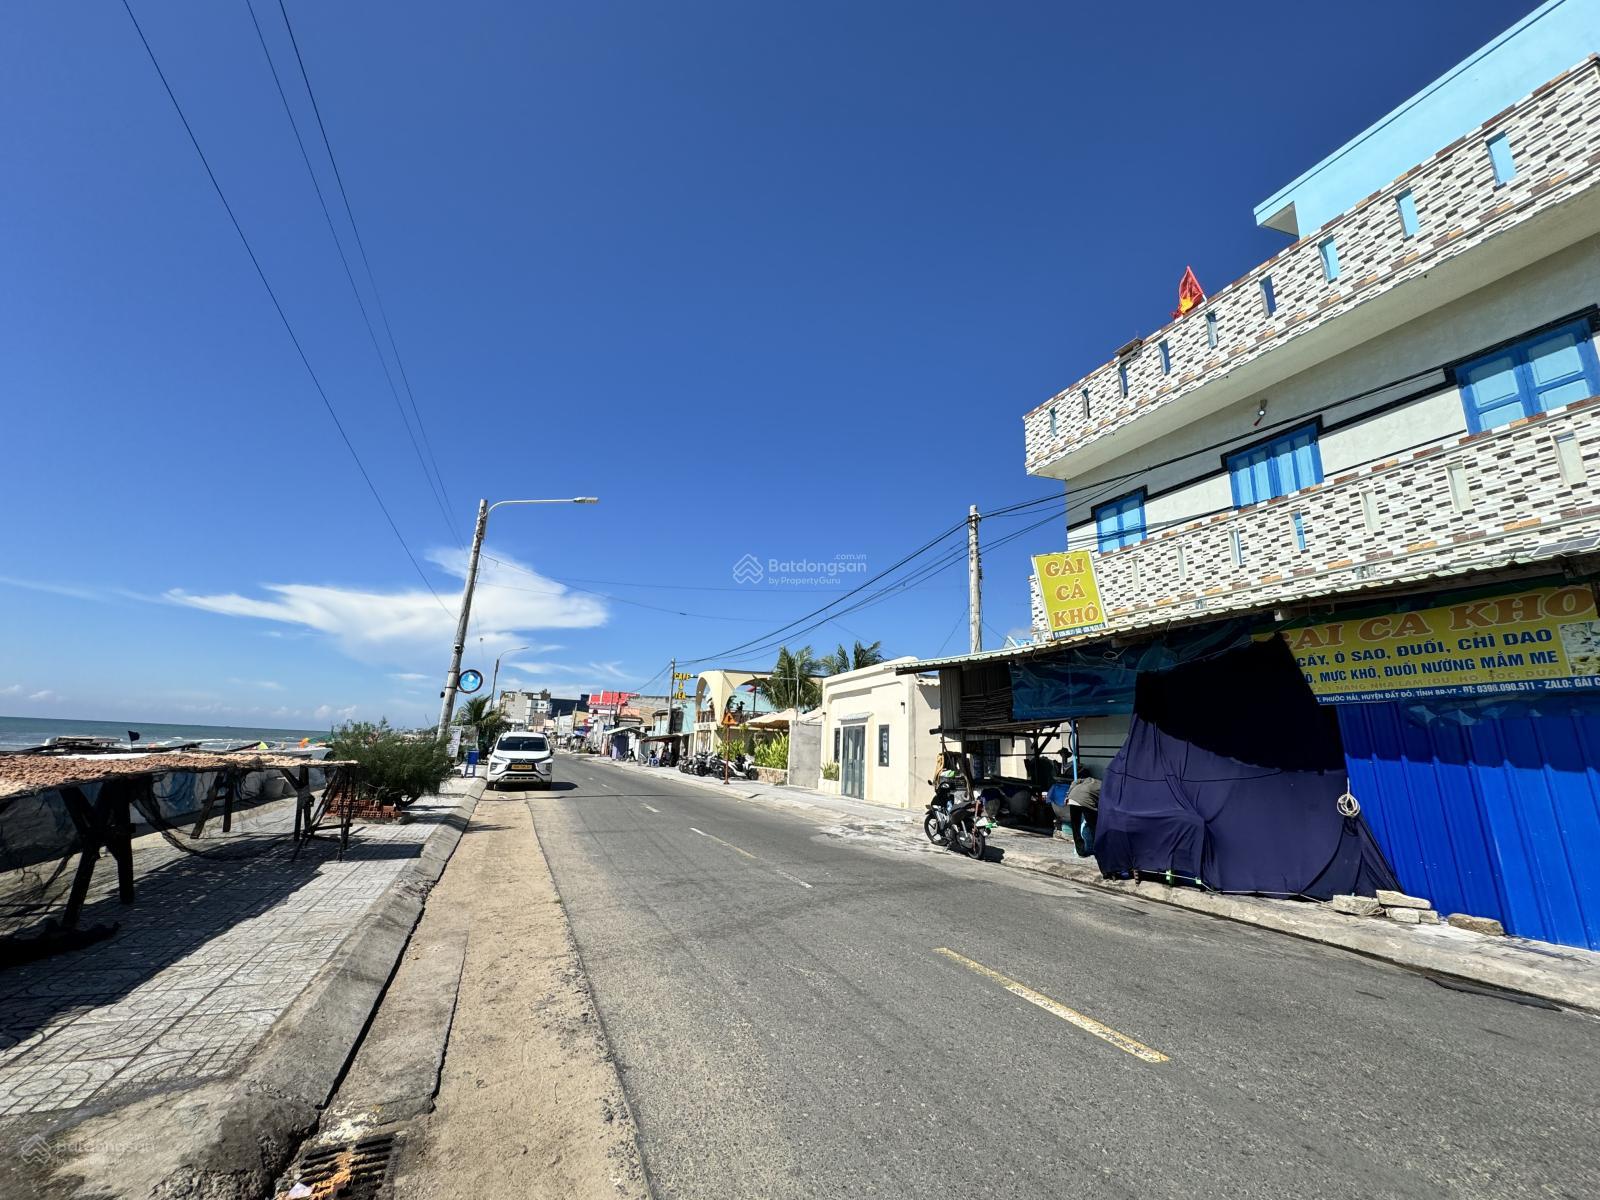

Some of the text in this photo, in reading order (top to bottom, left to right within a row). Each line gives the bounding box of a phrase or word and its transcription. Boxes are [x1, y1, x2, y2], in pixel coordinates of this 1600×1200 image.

[1045, 555, 1085, 577] GÁI
[1054, 602, 1099, 628] KHÔ
[1351, 648, 1391, 662] SAO,
[1502, 629, 1553, 646] DAO
[1319, 670, 1347, 683] MỰC
[1529, 650, 1559, 665] ME
[1544, 679, 1572, 689] ZALO:
